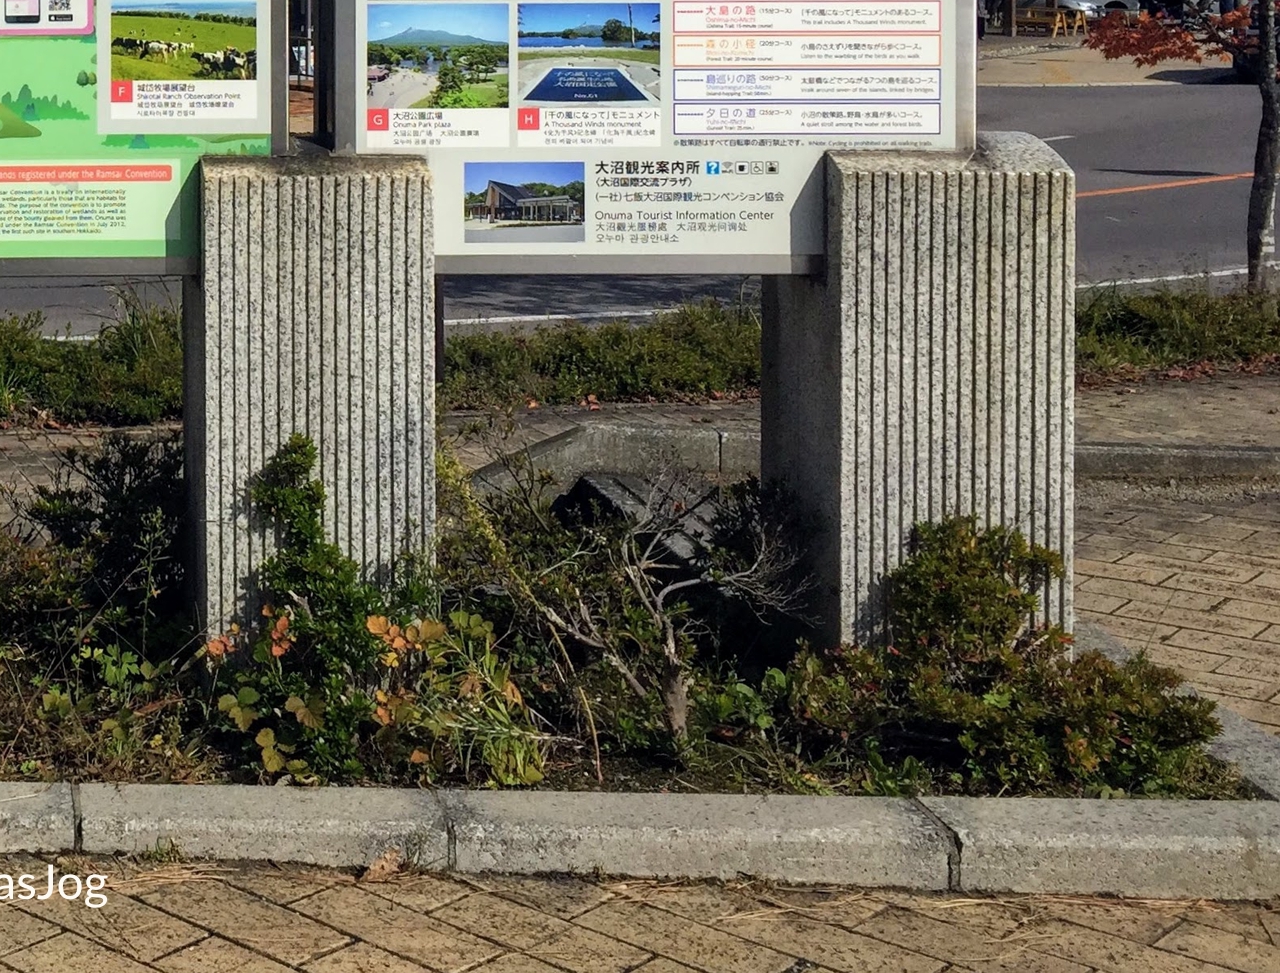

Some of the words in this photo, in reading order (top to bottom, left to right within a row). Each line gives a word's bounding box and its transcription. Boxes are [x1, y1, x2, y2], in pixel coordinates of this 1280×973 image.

[119, 87, 126, 97] F
[372, 114, 383, 124] G
[524, 115, 532, 124] H
[595, 161, 700, 175] 大沼観光案内所
[82, 170, 95, 179] the
[595, 211, 633, 221] Onuma
[636, 211, 673, 221] Tourist
[676, 211, 736, 221] Information
[739, 211, 774, 221] Center
